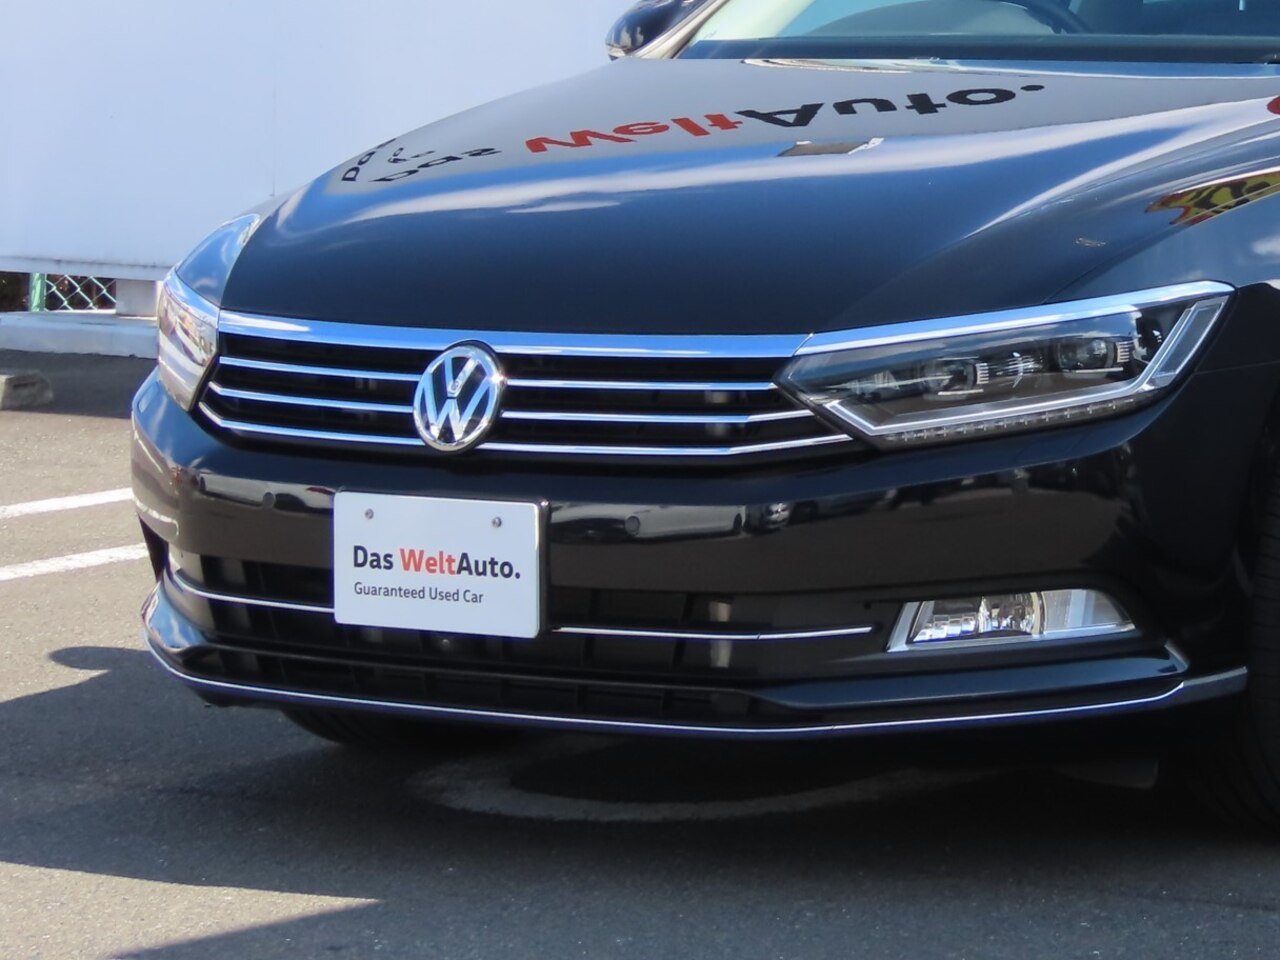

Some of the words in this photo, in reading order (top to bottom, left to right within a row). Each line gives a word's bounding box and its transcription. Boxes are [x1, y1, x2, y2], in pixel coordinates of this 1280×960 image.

[415, 346, 498, 450] VW
[353, 545, 394, 570] Das
[400, 548, 521, 580] WeltAuto.
[354, 582, 426, 600] Guaranteed
[429, 587, 460, 602] Used
[463, 590, 484, 604] Car
